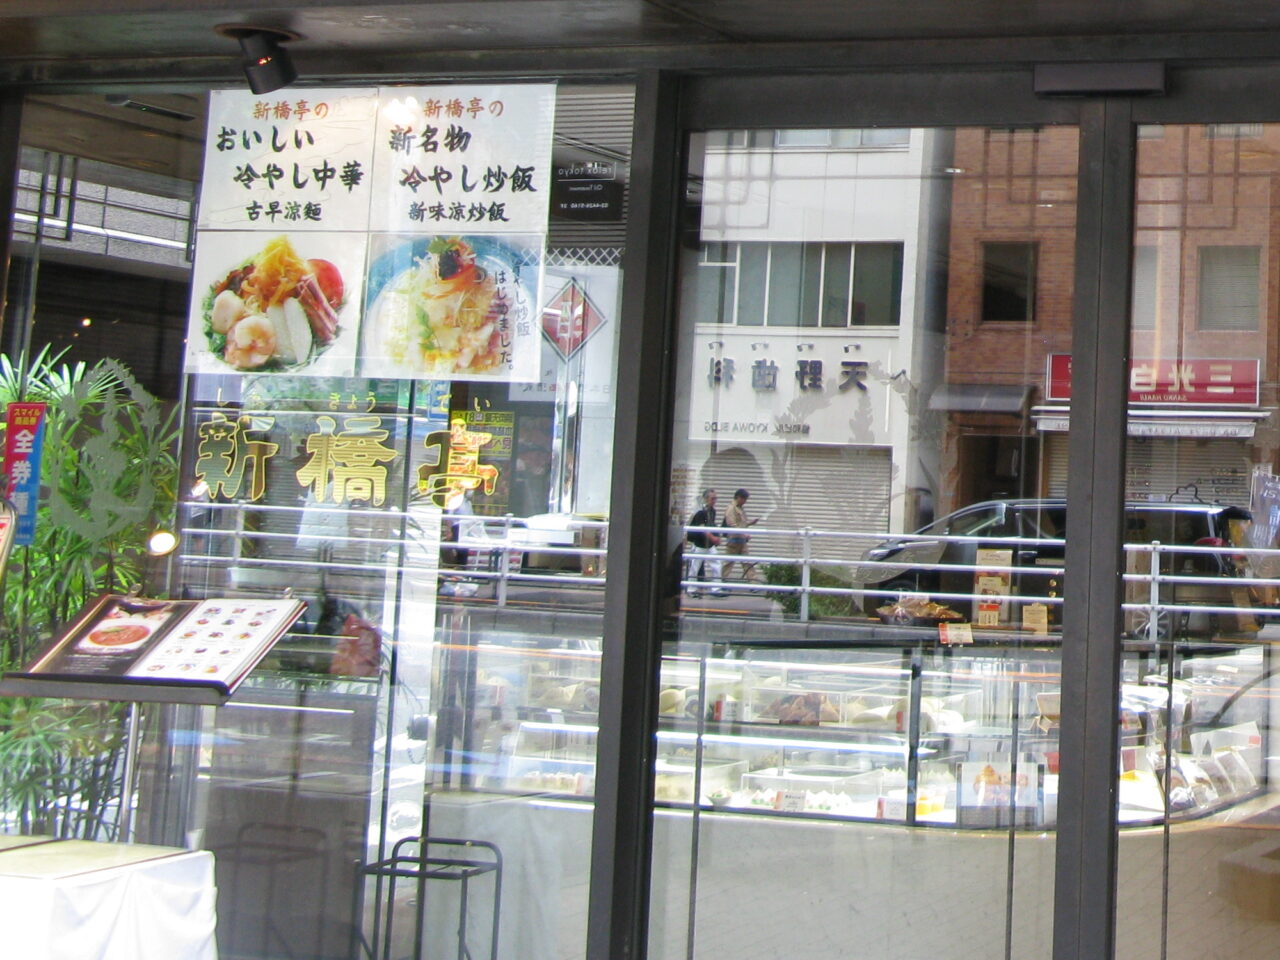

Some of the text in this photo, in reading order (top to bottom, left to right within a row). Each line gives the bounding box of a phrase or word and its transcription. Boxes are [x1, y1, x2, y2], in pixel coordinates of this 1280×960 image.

[253, 100, 329, 120] 新橋亭の
[423, 97, 504, 119] 新橋亭の
[216, 125, 315, 152] おいしい
[388, 124, 472, 156] 新名物
[233, 160, 365, 193] 冷やし中華
[399, 164, 538, 196] 冷やし炒飯
[408, 201, 510, 223] 新味涼炒飯
[195, 411, 499, 510] 新橋亭
